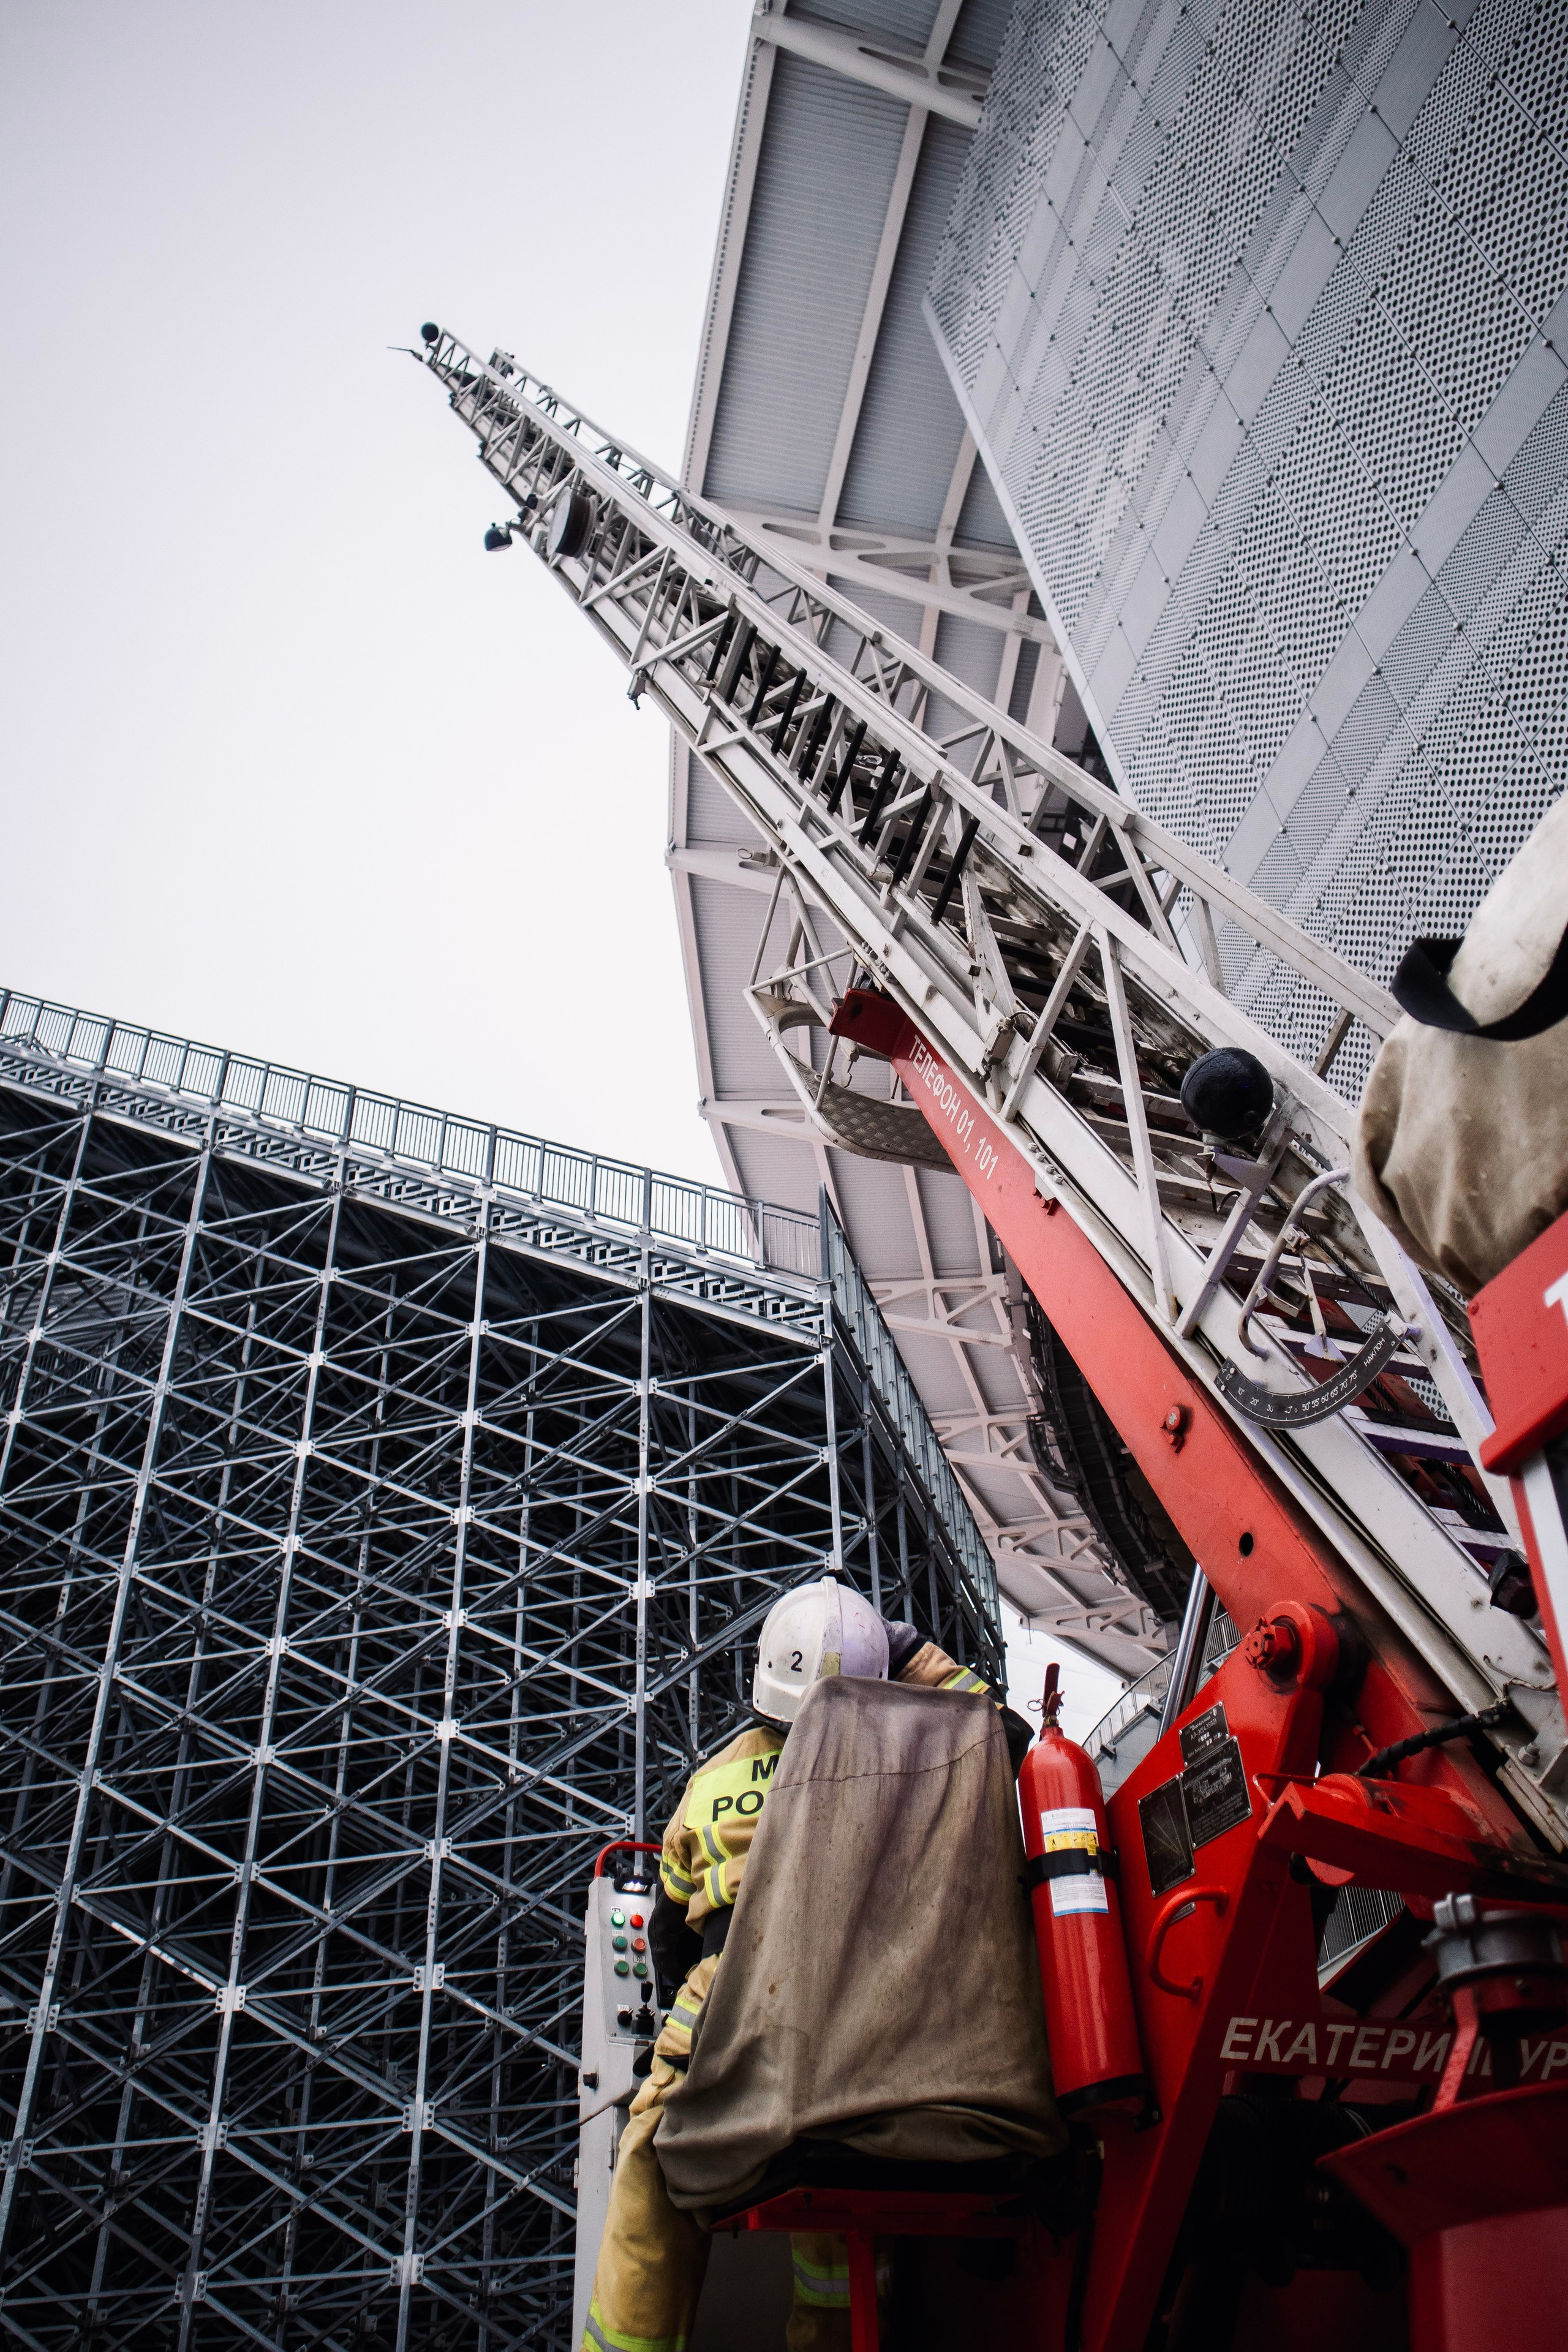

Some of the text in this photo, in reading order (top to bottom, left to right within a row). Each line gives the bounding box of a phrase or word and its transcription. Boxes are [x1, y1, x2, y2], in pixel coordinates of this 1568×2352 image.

[908, 1034, 999, 1180] ТЕЛЕФОН 01, 101
[1363, 1337, 1385, 1367] НАКЛОН
[1302, 1401, 1311, 1411] 50°
[790, 1650, 803, 1673] 2
[751, 1754, 780, 1782] М
[712, 1790, 764, 1822] РО
[1219, 2016, 1568, 2080] ЕКАТЕРИУР
